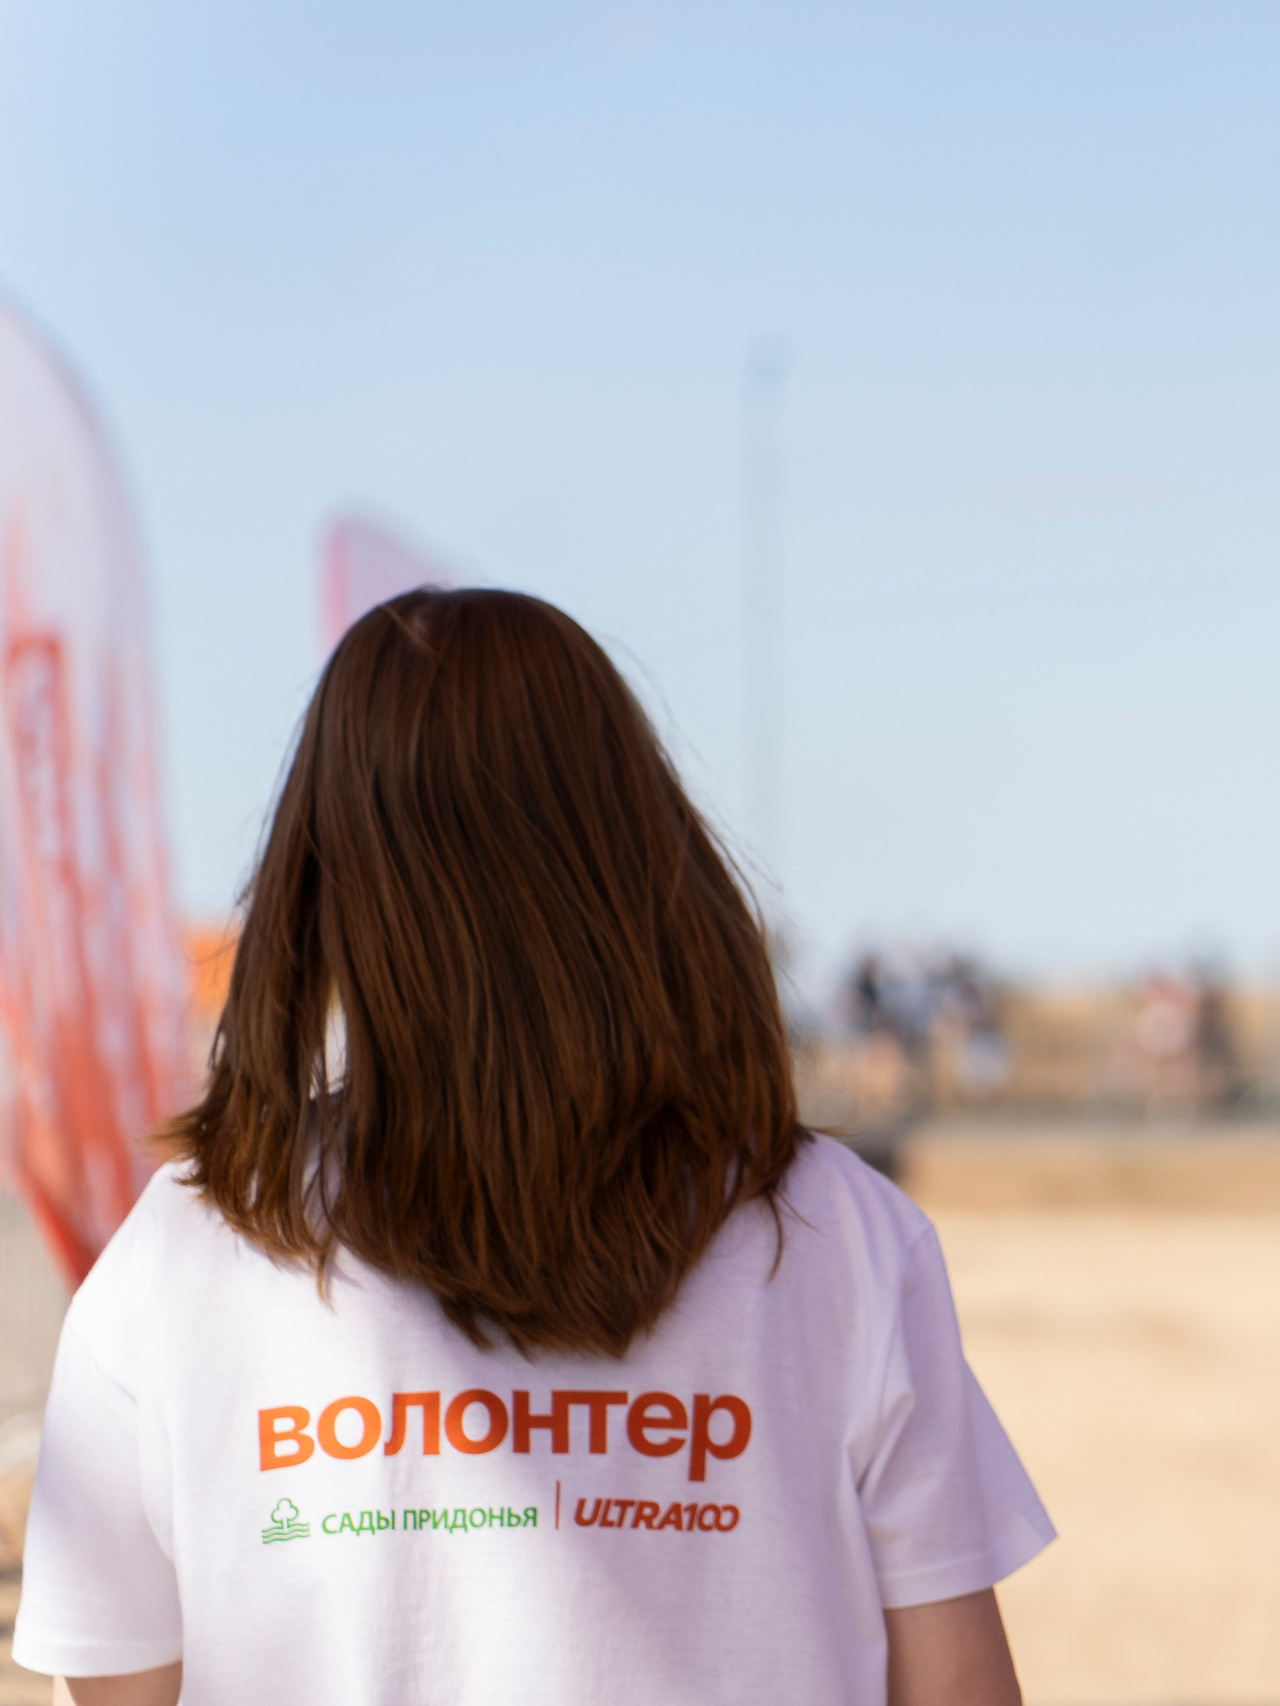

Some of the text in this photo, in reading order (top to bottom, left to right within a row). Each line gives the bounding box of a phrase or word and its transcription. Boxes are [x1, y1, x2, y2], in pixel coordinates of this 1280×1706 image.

[258, 1388, 753, 1482] волонтер
[321, 1506, 538, 1534] САДЫ ПРИДОНЬЯ
[573, 1497, 741, 1533] ULTRA100
